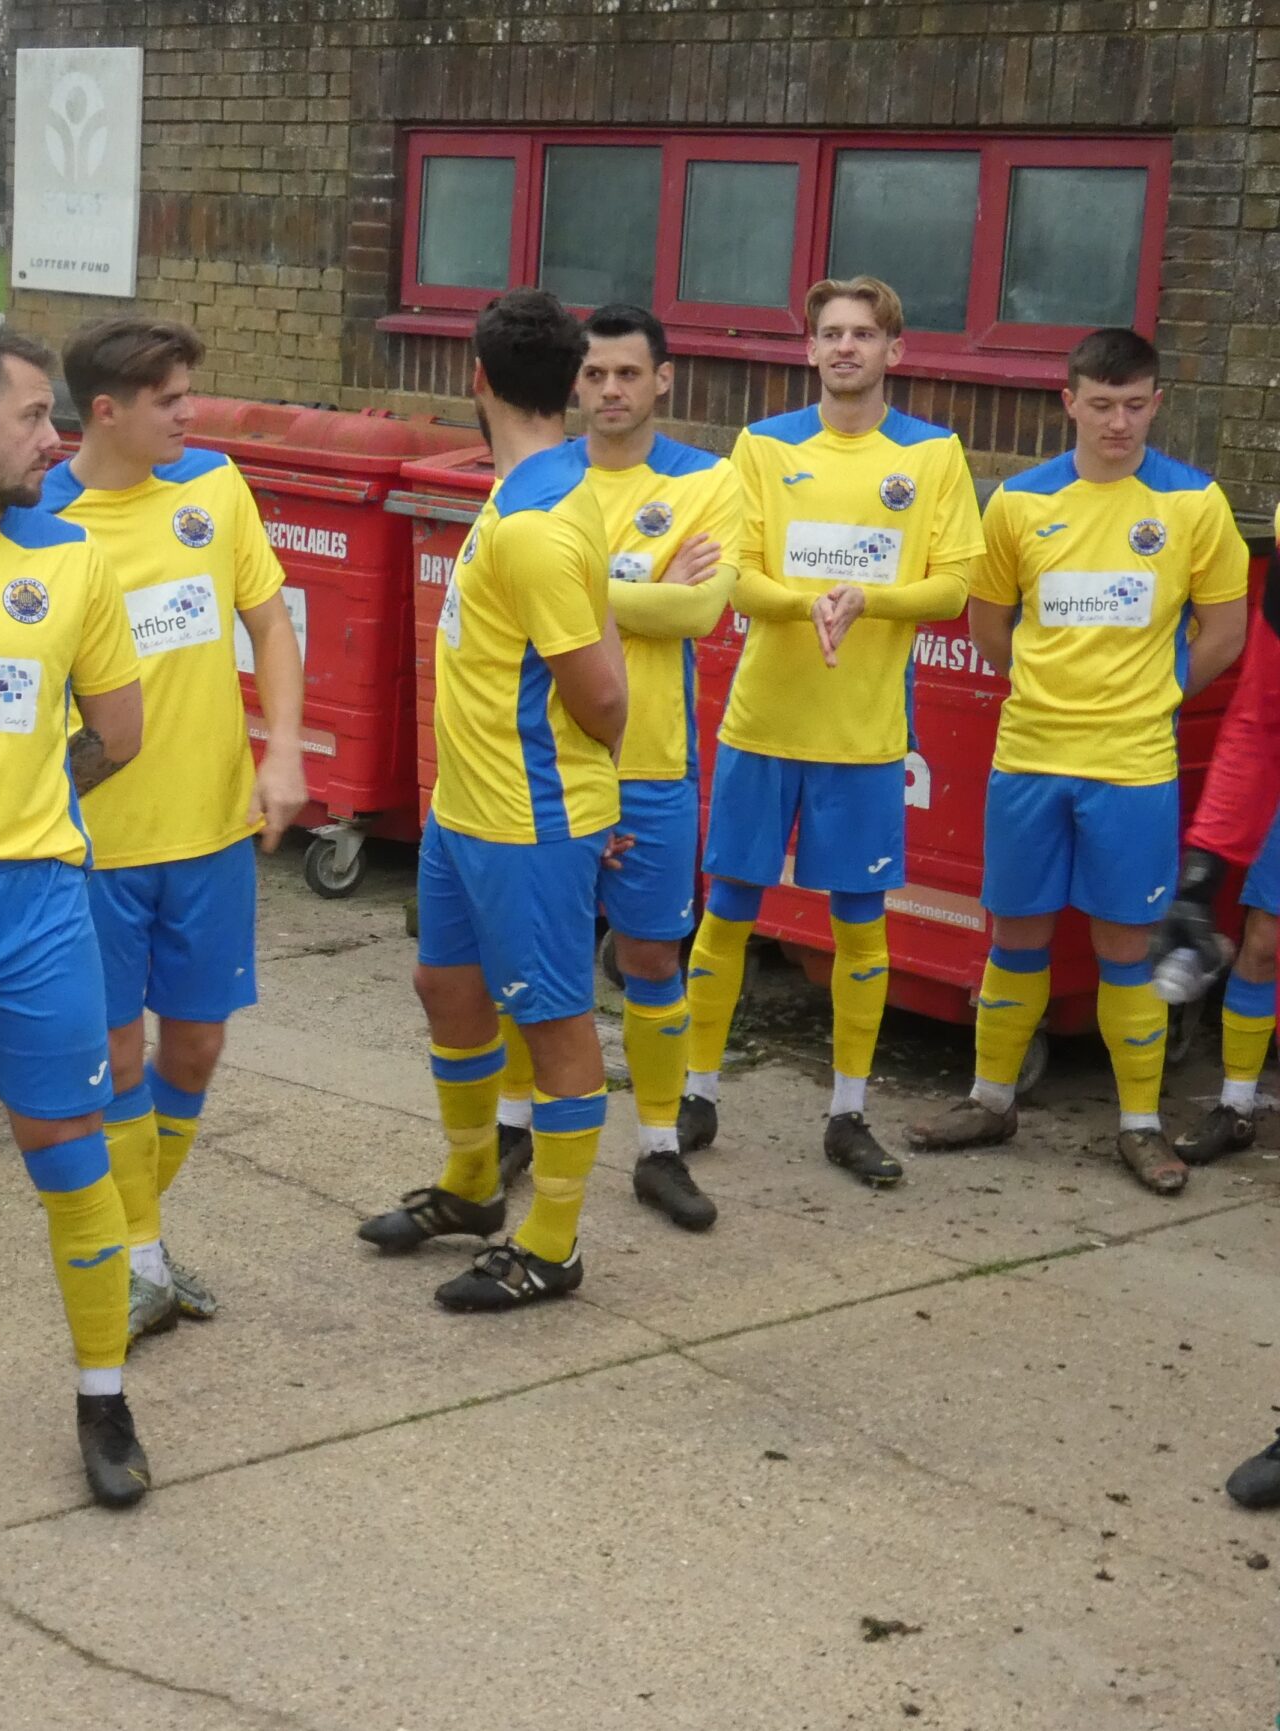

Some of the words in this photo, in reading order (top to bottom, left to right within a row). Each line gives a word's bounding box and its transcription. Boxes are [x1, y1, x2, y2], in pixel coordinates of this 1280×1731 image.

[30, 257, 77, 270] LOTTERY
[81, 261, 110, 273] FUND
[790, 546, 869, 568] wightfibre
[420, 553, 454, 586] DRY
[1044, 596, 1118, 615] wightfibre
